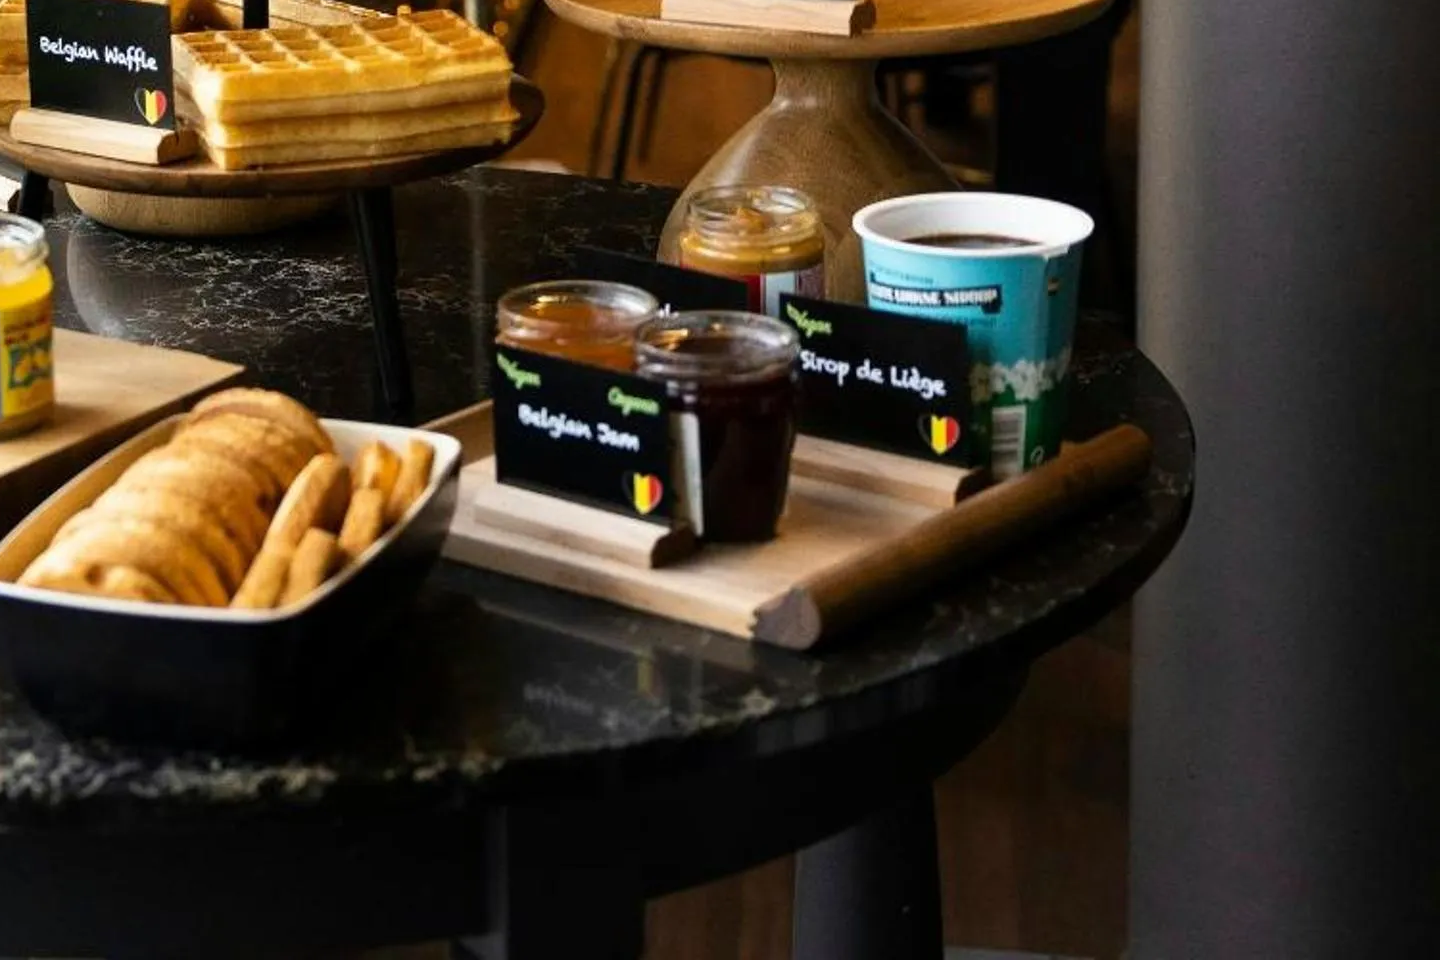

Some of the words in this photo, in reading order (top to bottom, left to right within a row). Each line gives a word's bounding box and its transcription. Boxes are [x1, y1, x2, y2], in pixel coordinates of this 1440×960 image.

[39, 36, 100, 63] Belgian
[104, 45, 159, 72] Waffle
[799, 350, 850, 386] Sirop
[856, 358, 884, 384] de
[889, 365, 947, 400] Liège
[517, 402, 593, 440] Belgian
[596, 422, 641, 452] Jam
